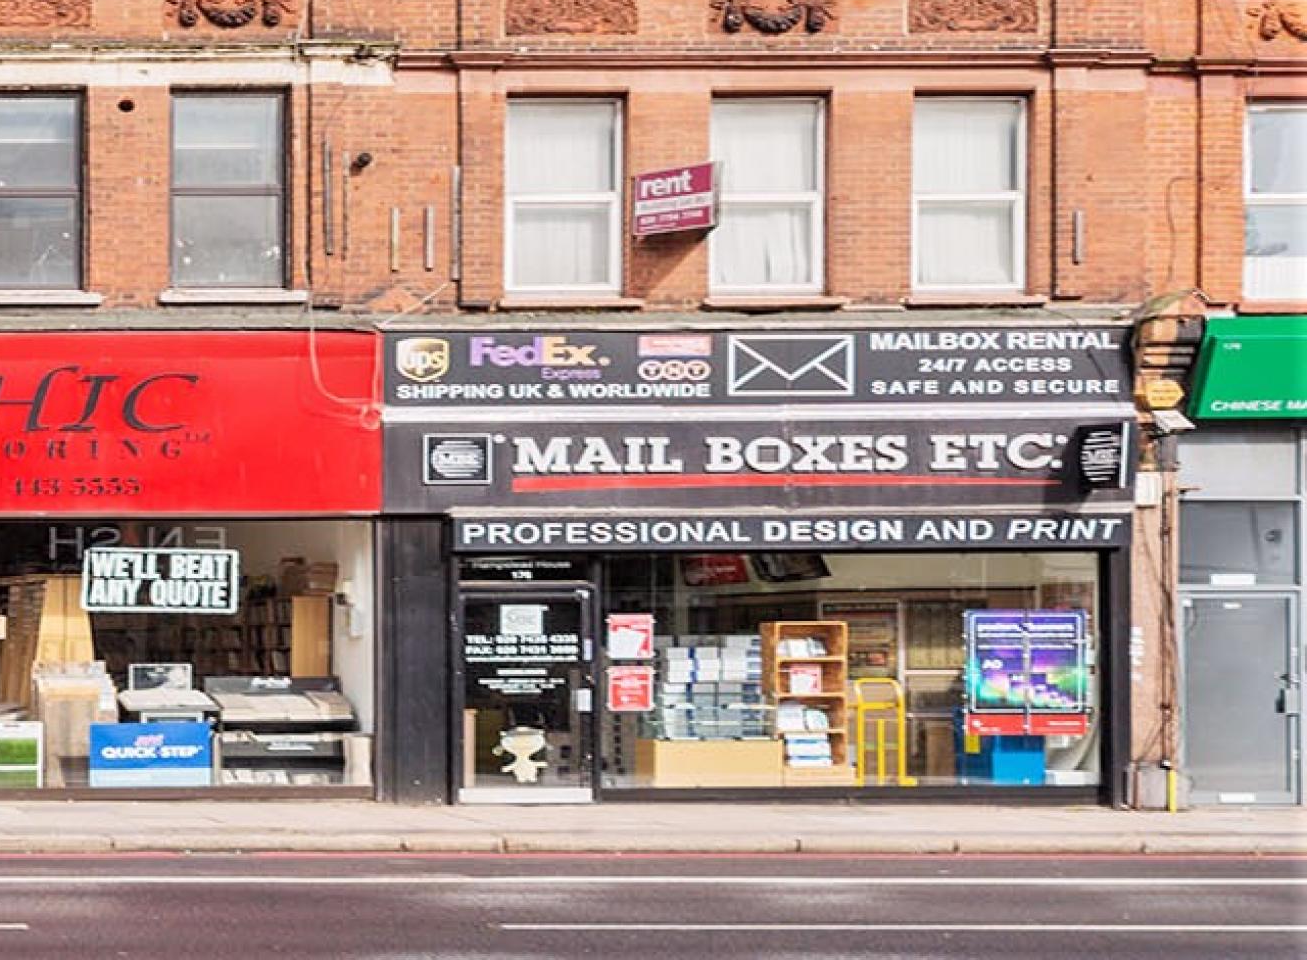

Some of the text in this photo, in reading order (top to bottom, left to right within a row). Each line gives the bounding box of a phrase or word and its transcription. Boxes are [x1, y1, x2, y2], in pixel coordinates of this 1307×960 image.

[640, 169, 692, 198] rent
[870, 332, 1120, 350] MAILBOX RENTAL
[404, 349, 444, 376] ups
[541, 367, 602, 380] Express
[638, 359, 711, 381] TNT
[918, 357, 1073, 373] 24/7 ACCESS
[396, 383, 712, 399] SHIPPING UK & WORLDWIDE
[871, 379, 1121, 395] SAFE AND SECURE
[1210, 399, 1281, 412] CHINESE
[511, 436, 683, 473] MAIL
[704, 435, 908, 472] BOXES
[462, 518, 1122, 544] PROFESSIONAL DESIGN AND PRINT
[90, 552, 229, 580] WE'LL BEAT
[89, 579, 228, 607] ANY QUOTE
